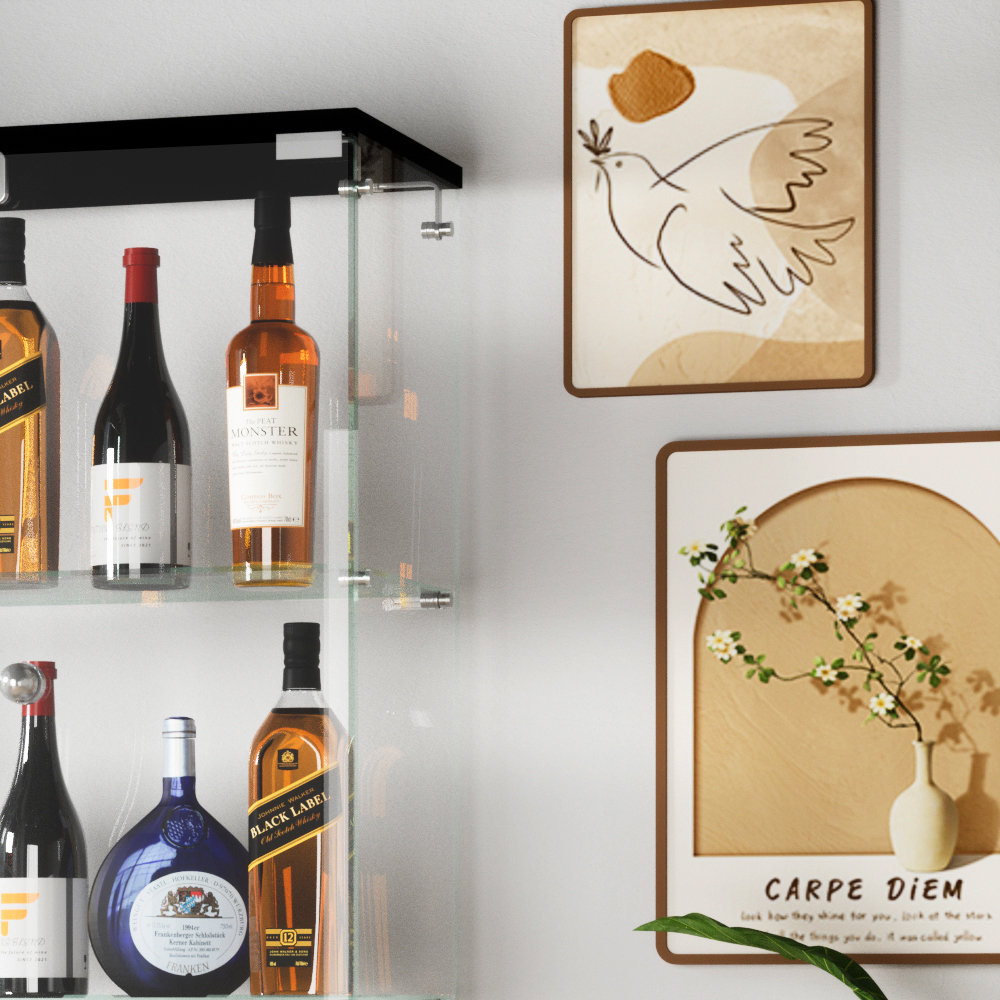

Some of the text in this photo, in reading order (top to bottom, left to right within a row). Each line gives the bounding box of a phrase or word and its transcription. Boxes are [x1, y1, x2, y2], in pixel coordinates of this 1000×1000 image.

[231, 426, 298, 438] MONSTER
[257, 787, 315, 819] JOHNNIE WALKER
[249, 791, 331, 839] BLACK LABEL
[765, 876, 863, 902] CARPE
[850, 911, 866, 921] for
[283, 932, 294, 943] 12
[166, 961, 210, 973] FRANKEN
